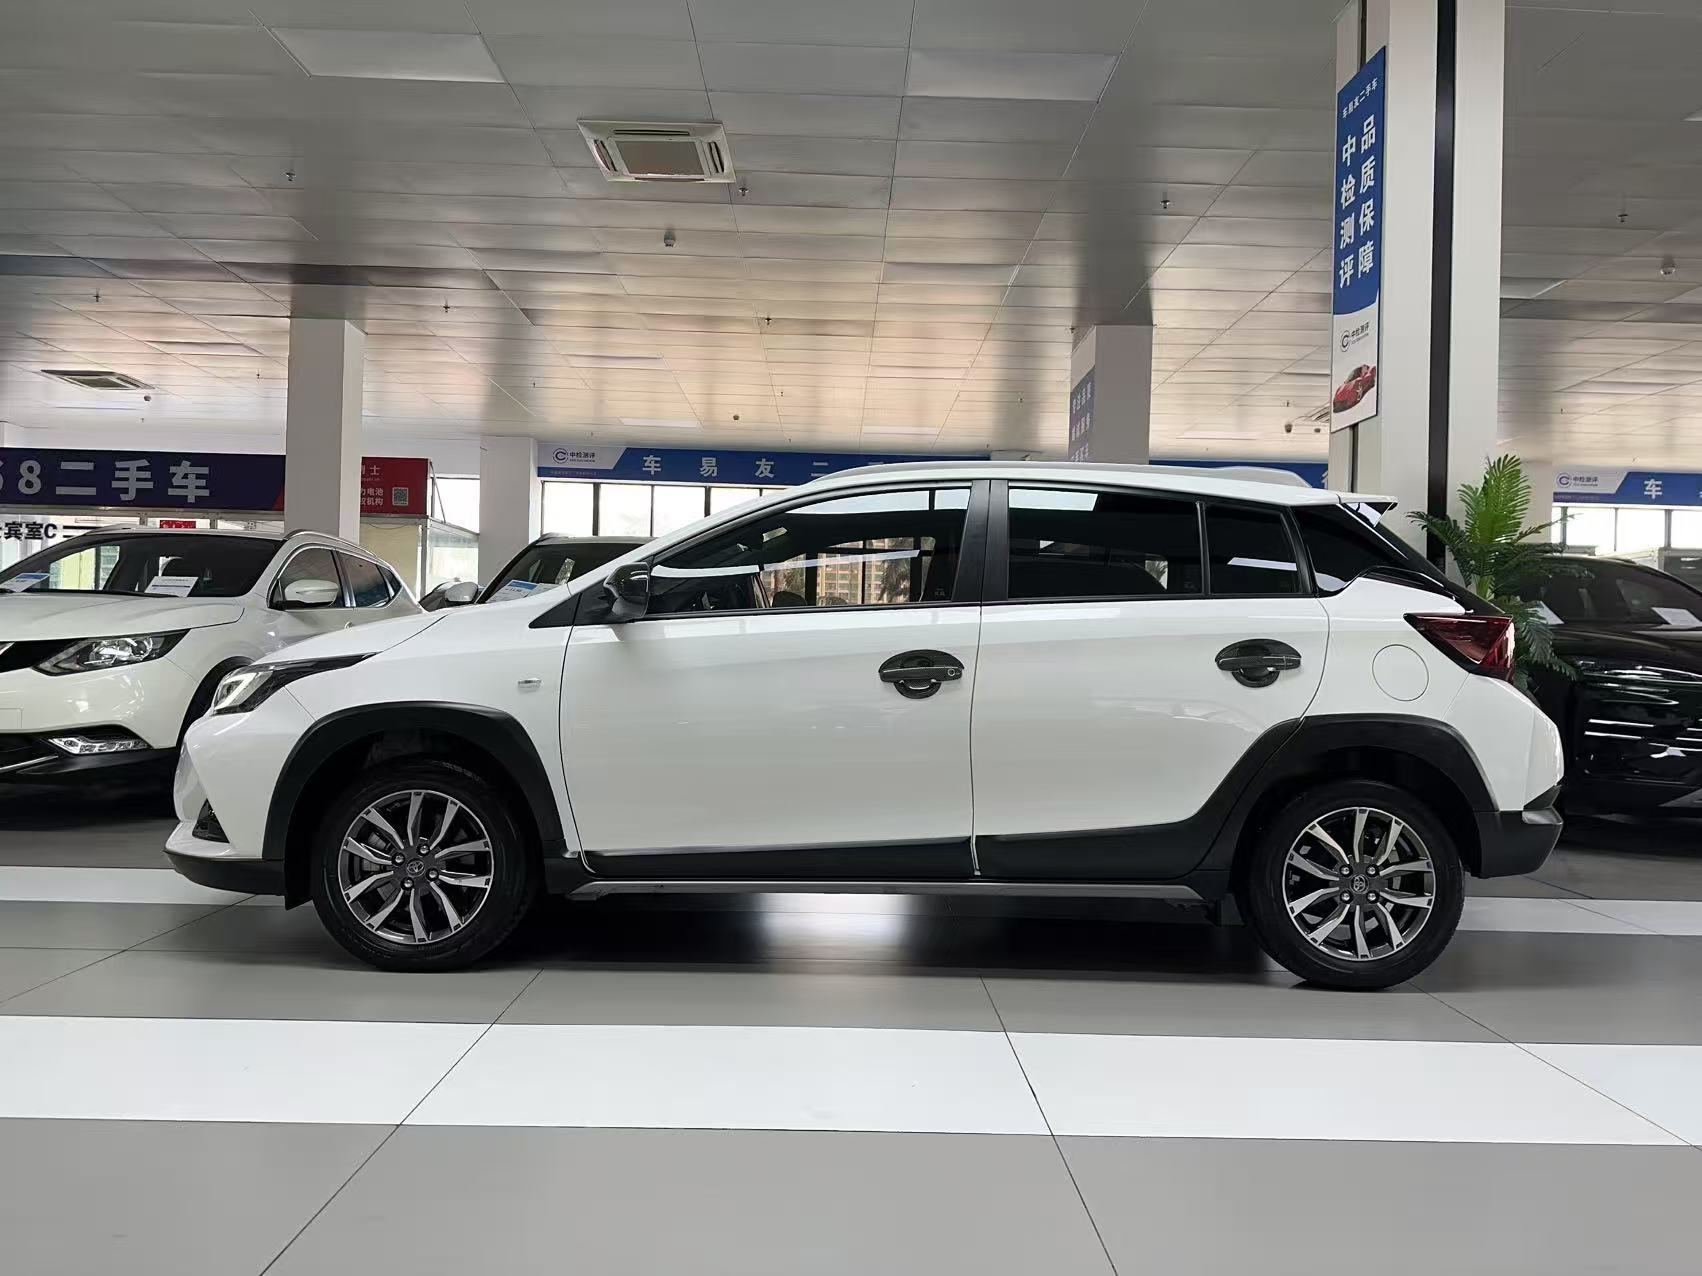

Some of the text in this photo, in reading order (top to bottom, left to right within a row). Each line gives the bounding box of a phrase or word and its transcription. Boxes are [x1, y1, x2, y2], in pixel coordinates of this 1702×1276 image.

[1339, 134, 1356, 290] 中检测评
[1358, 113, 1377, 274] 品质保障
[0, 459, 210, 503] 8二手车
[361, 465, 380, 475] 士
[0, 521, 57, 541] 宾室C
